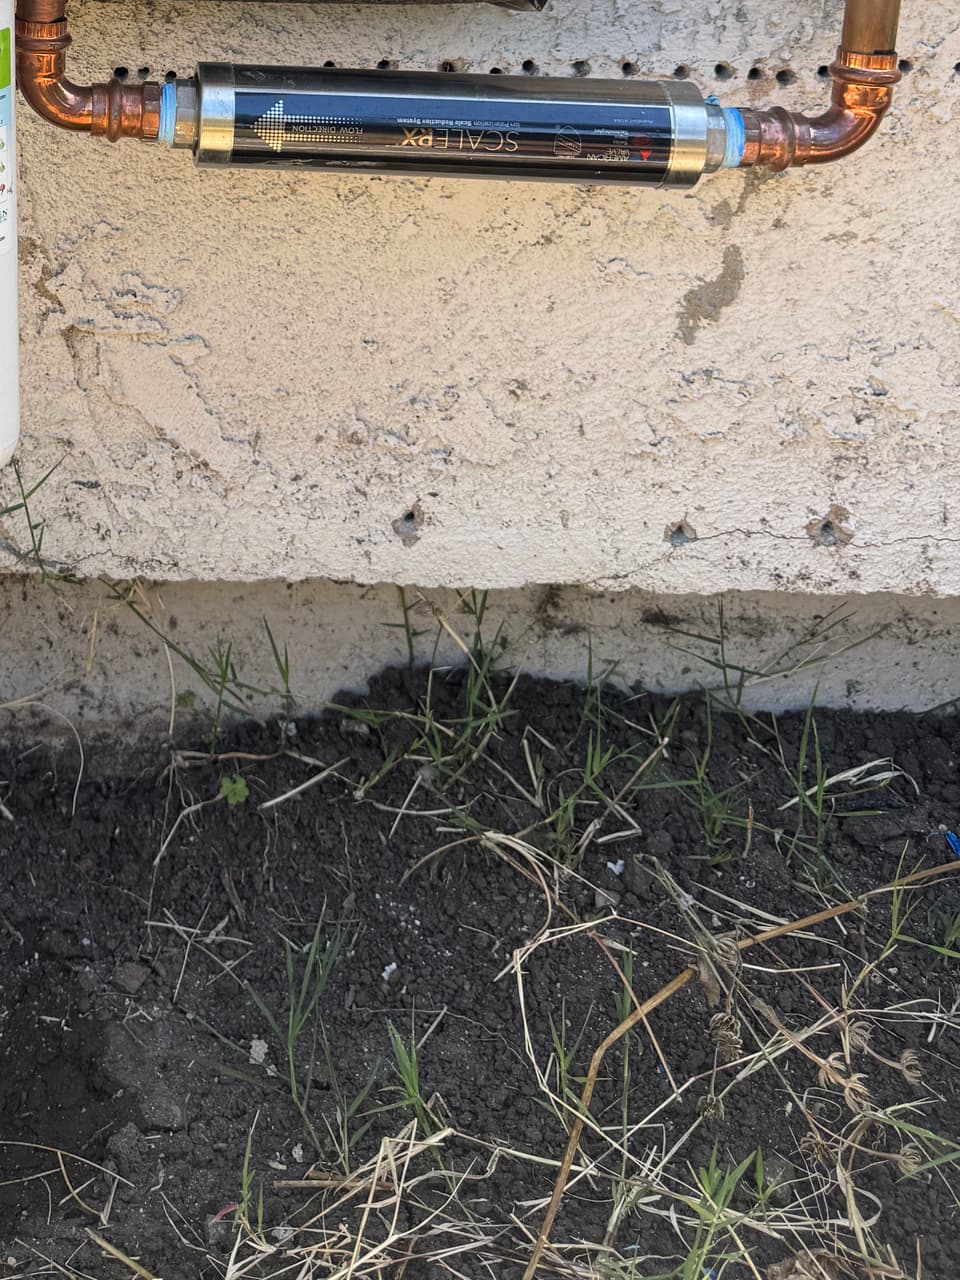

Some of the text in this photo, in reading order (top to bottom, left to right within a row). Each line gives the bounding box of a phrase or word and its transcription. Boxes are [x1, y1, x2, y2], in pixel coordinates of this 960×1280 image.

[292, 124, 364, 135] FLOW DIRECTION
[399, 127, 520, 152] SCALERX
